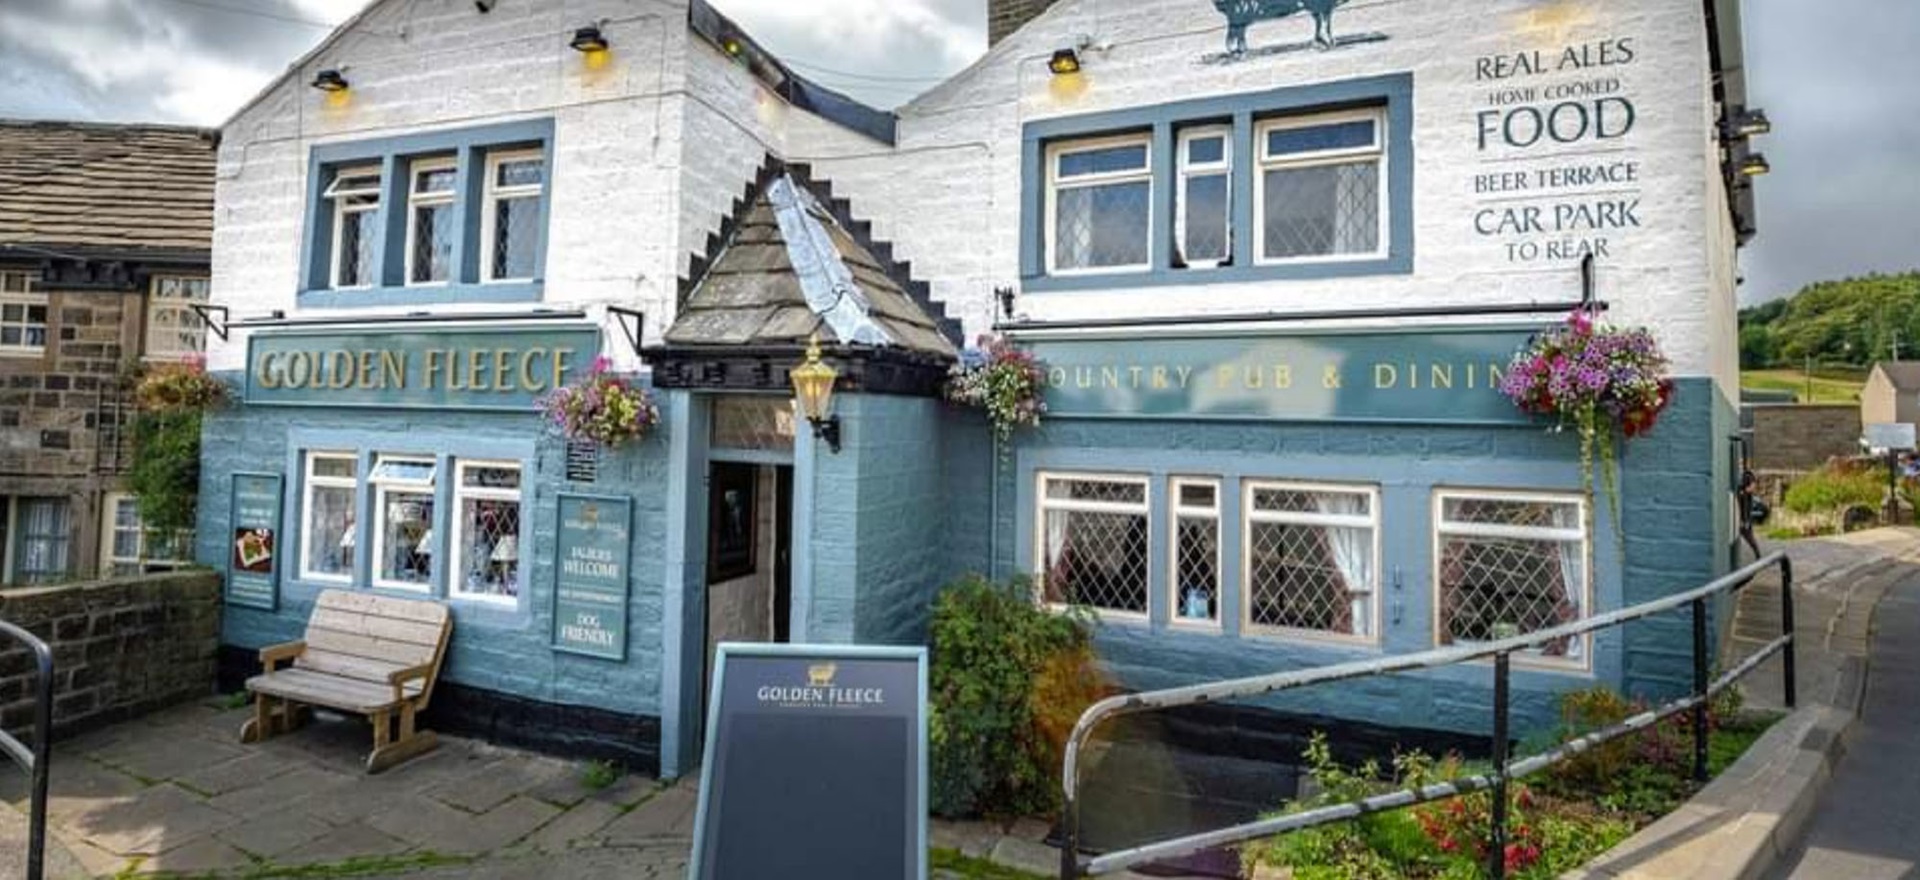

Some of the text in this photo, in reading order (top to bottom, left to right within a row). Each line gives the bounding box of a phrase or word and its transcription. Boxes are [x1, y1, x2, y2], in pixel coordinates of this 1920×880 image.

[1476, 37, 1635, 81] REAL ALES
[1489, 78, 1620, 105] HOME COOKED
[1476, 97, 1635, 151] FOOD
[1475, 162, 1640, 194] BEER TERRACE
[1474, 200, 1641, 236] CAR PARK
[1505, 237, 1610, 262] TO REAR
[257, 347, 576, 392] GOLDEN FLEECE
[1050, 363, 1505, 390] OUNTRY PUB & DININ
[757, 686, 884, 704] GOLDEN FLEECE
